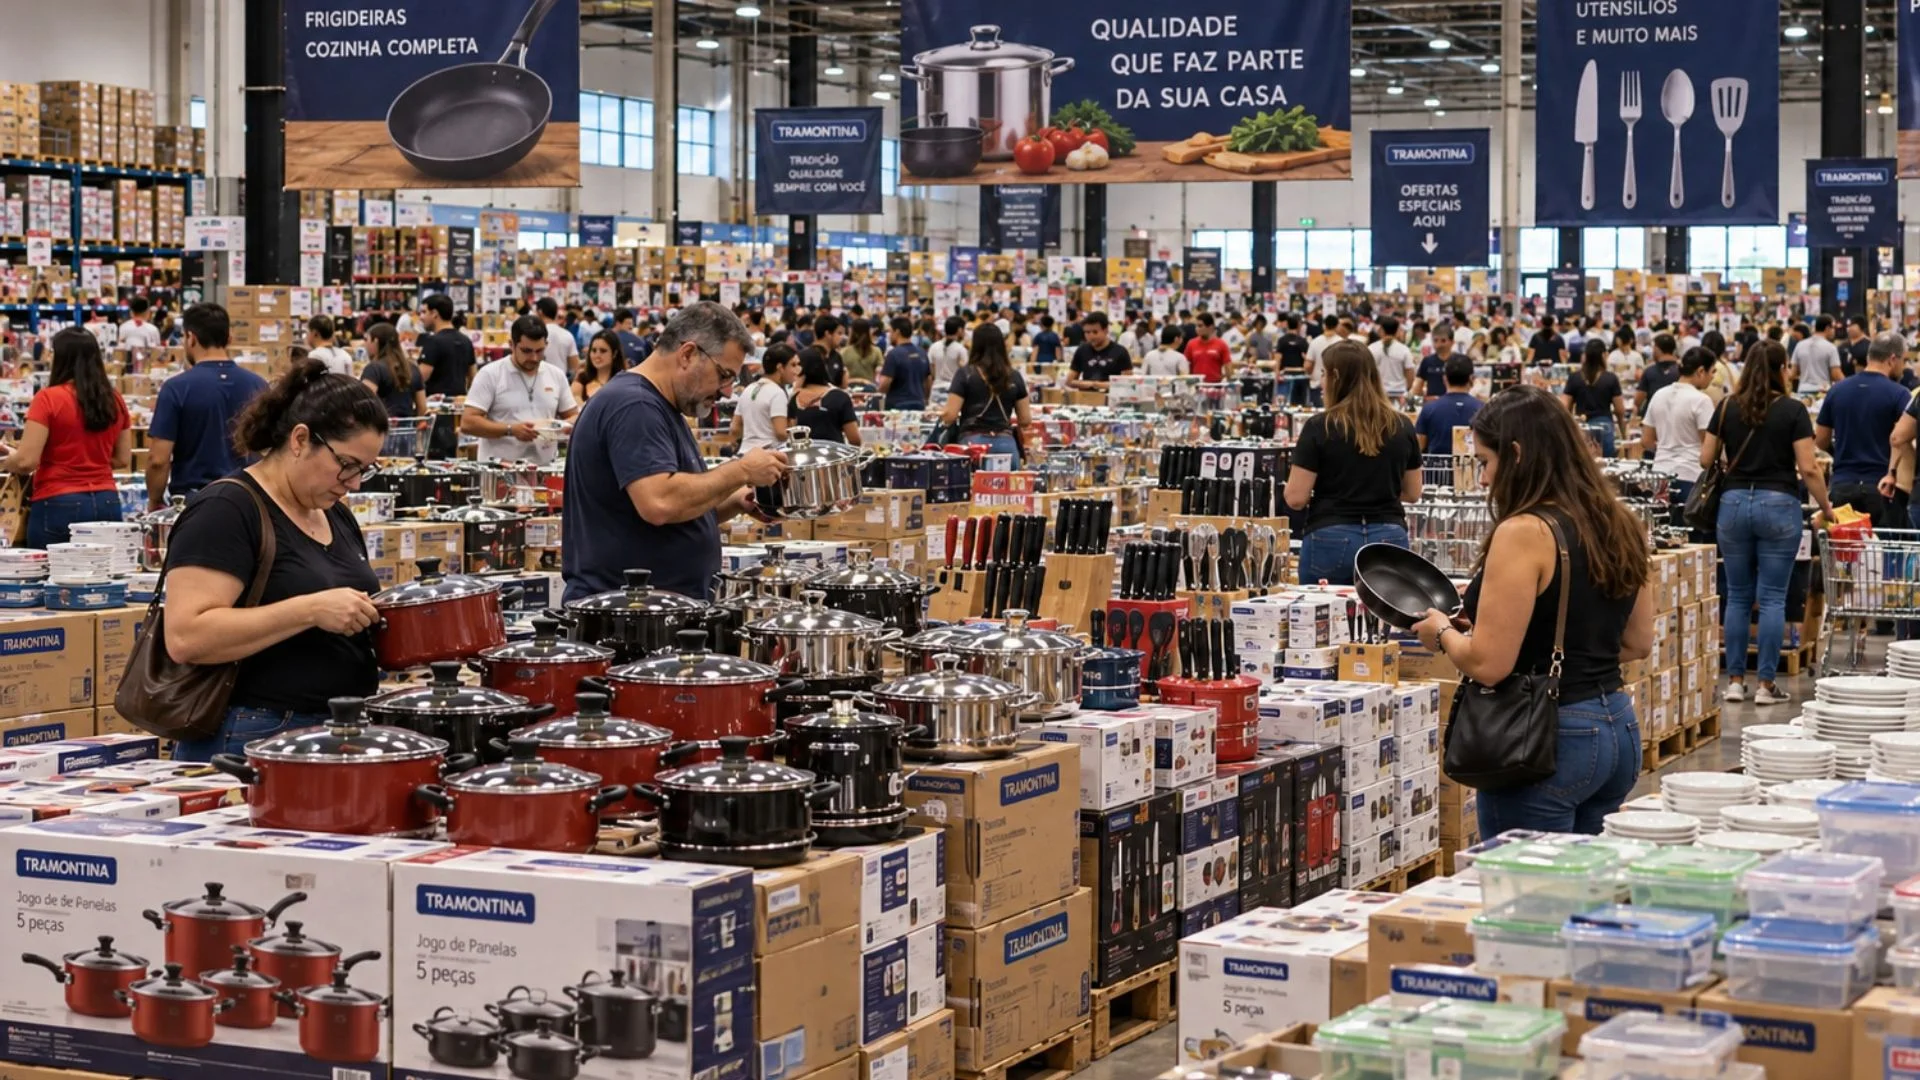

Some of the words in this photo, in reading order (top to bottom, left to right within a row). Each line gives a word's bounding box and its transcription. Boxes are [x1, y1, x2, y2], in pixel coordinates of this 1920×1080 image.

[305, 9, 407, 28] FRIGIDEIRAS
[1091, 15, 1237, 41] QUALIDADE
[1577, 29, 1587, 45] E
[1592, 27, 1649, 44] MUITO
[1655, 25, 1698, 42] MAIS
[305, 40, 382, 58] COZINHA
[387, 37, 479, 56] COMPLETA
[1111, 52, 1163, 75] QUE
[1173, 51, 1217, 73] FAZ
[1228, 49, 1304, 72] PARTE
[1117, 88, 1151, 109] DA
[1160, 87, 1210, 108] SUA
[1220, 84, 1287, 107] CASA
[778, 126, 859, 138] TRAMONTINA
[1392, 148, 1468, 160] TRAMONTINA
[1401, 184, 1458, 196] OFERTAS
[1398, 200, 1462, 212] ESPECIAIS
[1412, 215, 1446, 227] AQUI
[23, 857, 110, 879] TRAMONTINA
[425, 892, 527, 917] TRAMONTINA
[17, 912, 25, 929] 5
[28, 917, 65, 934] peças
[416, 933, 446, 953] Jogo
[449, 936, 466, 952] de
[468, 938, 517, 958] Panelas
[416, 960, 427, 980] 5
[431, 966, 476, 987] peças
[1399, 975, 1490, 997] TRAMONTINA
